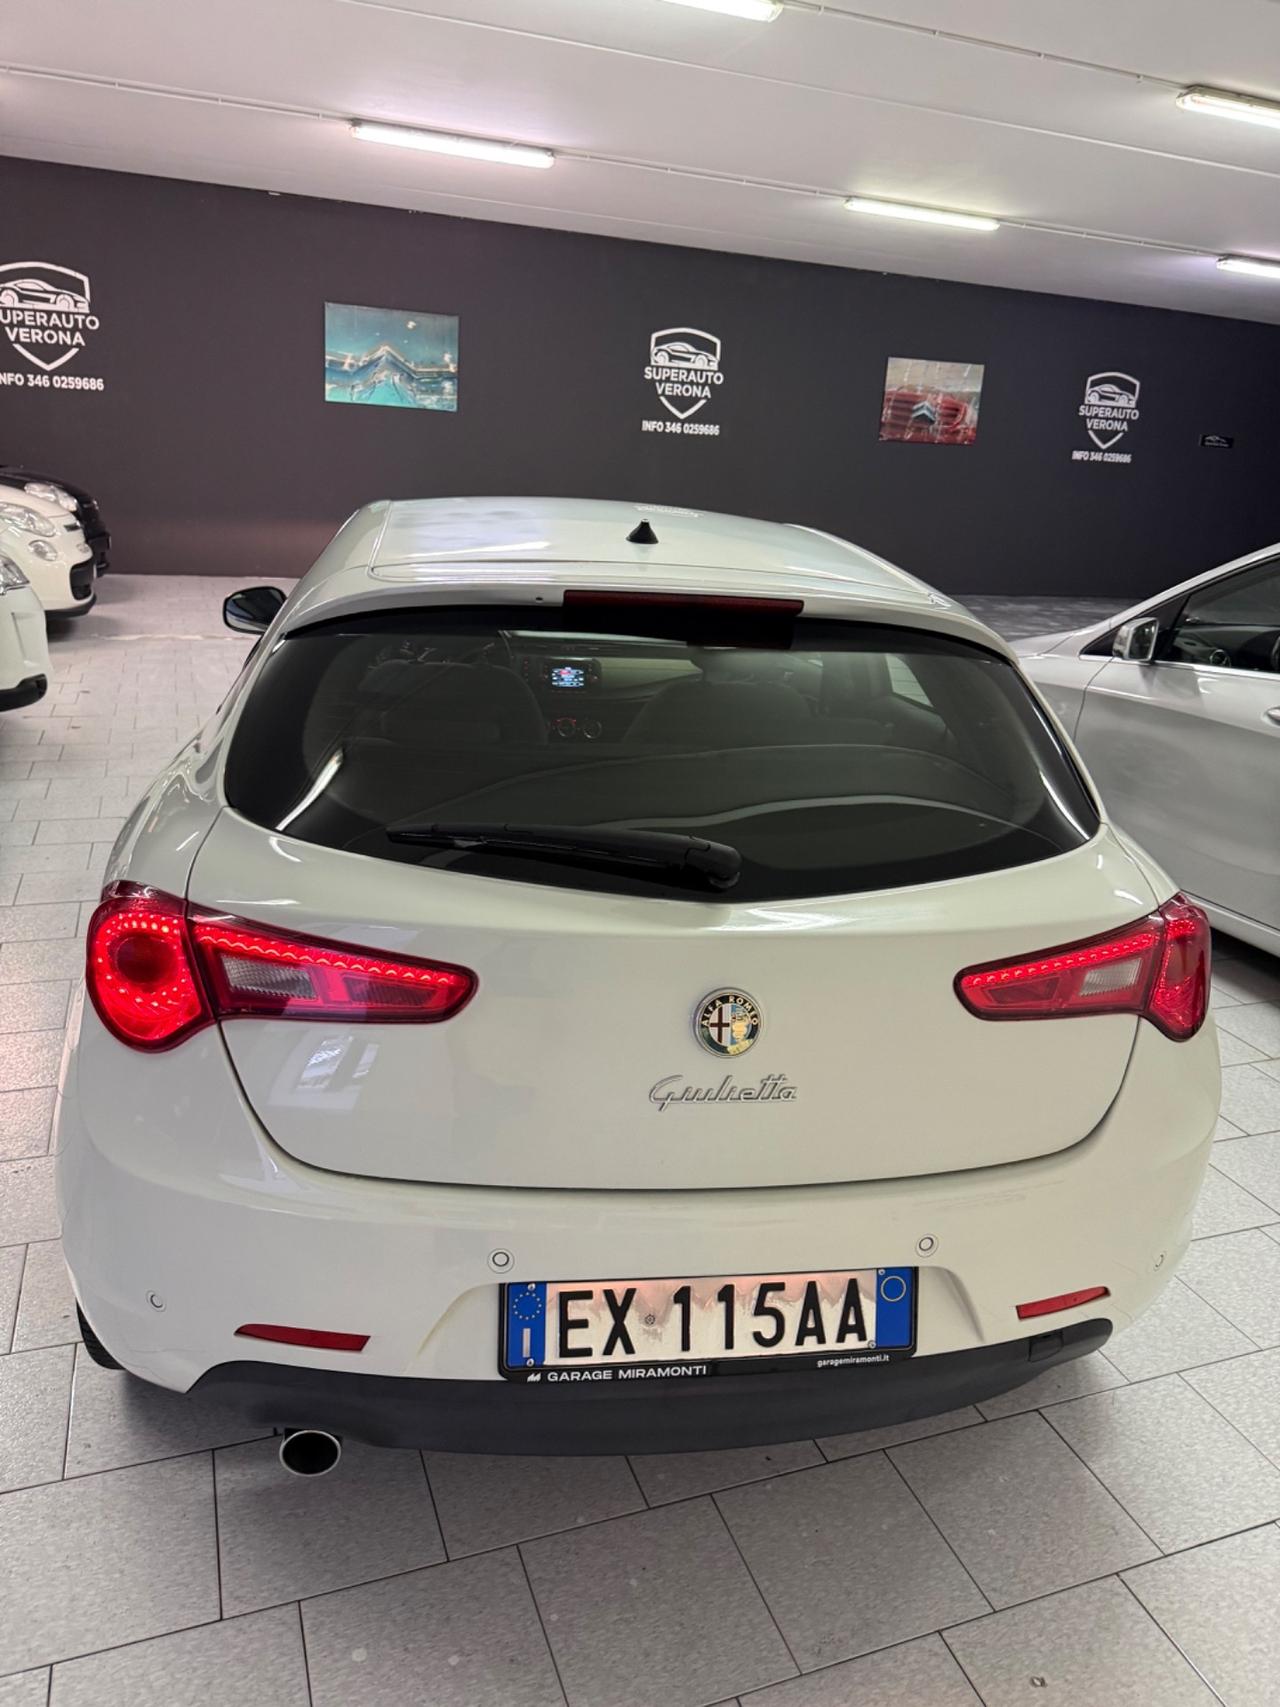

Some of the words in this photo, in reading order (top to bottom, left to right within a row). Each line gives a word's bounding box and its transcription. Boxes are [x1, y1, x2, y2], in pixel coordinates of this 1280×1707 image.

[0, 309, 100, 330] UPERAUTO
[5, 326, 86, 347] VERONA
[0, 372, 24, 386] NFO
[26, 374, 50, 388] 346
[52, 376, 104, 391] 0259686
[644, 366, 724, 385] SUPERAUTO
[655, 382, 712, 399] VERONA
[1078, 405, 1140, 420] SUPERAUTO
[641, 420, 664, 432] INFO
[665, 422, 682, 433] 346
[1086, 418, 1128, 432] VERONA
[701, 999, 723, 1027] ALFA
[728, 995, 760, 1026] ROMEO
[649, 1074, 798, 1112] Giulietta
[558, 1288, 636, 1358] EX
[673, 1278, 868, 1352] 115AA
[816, 1354, 890, 1368] garagemiramonti.it
[547, 1370, 613, 1382] GARAGE
[618, 1365, 707, 1380] MIRAMONTI
